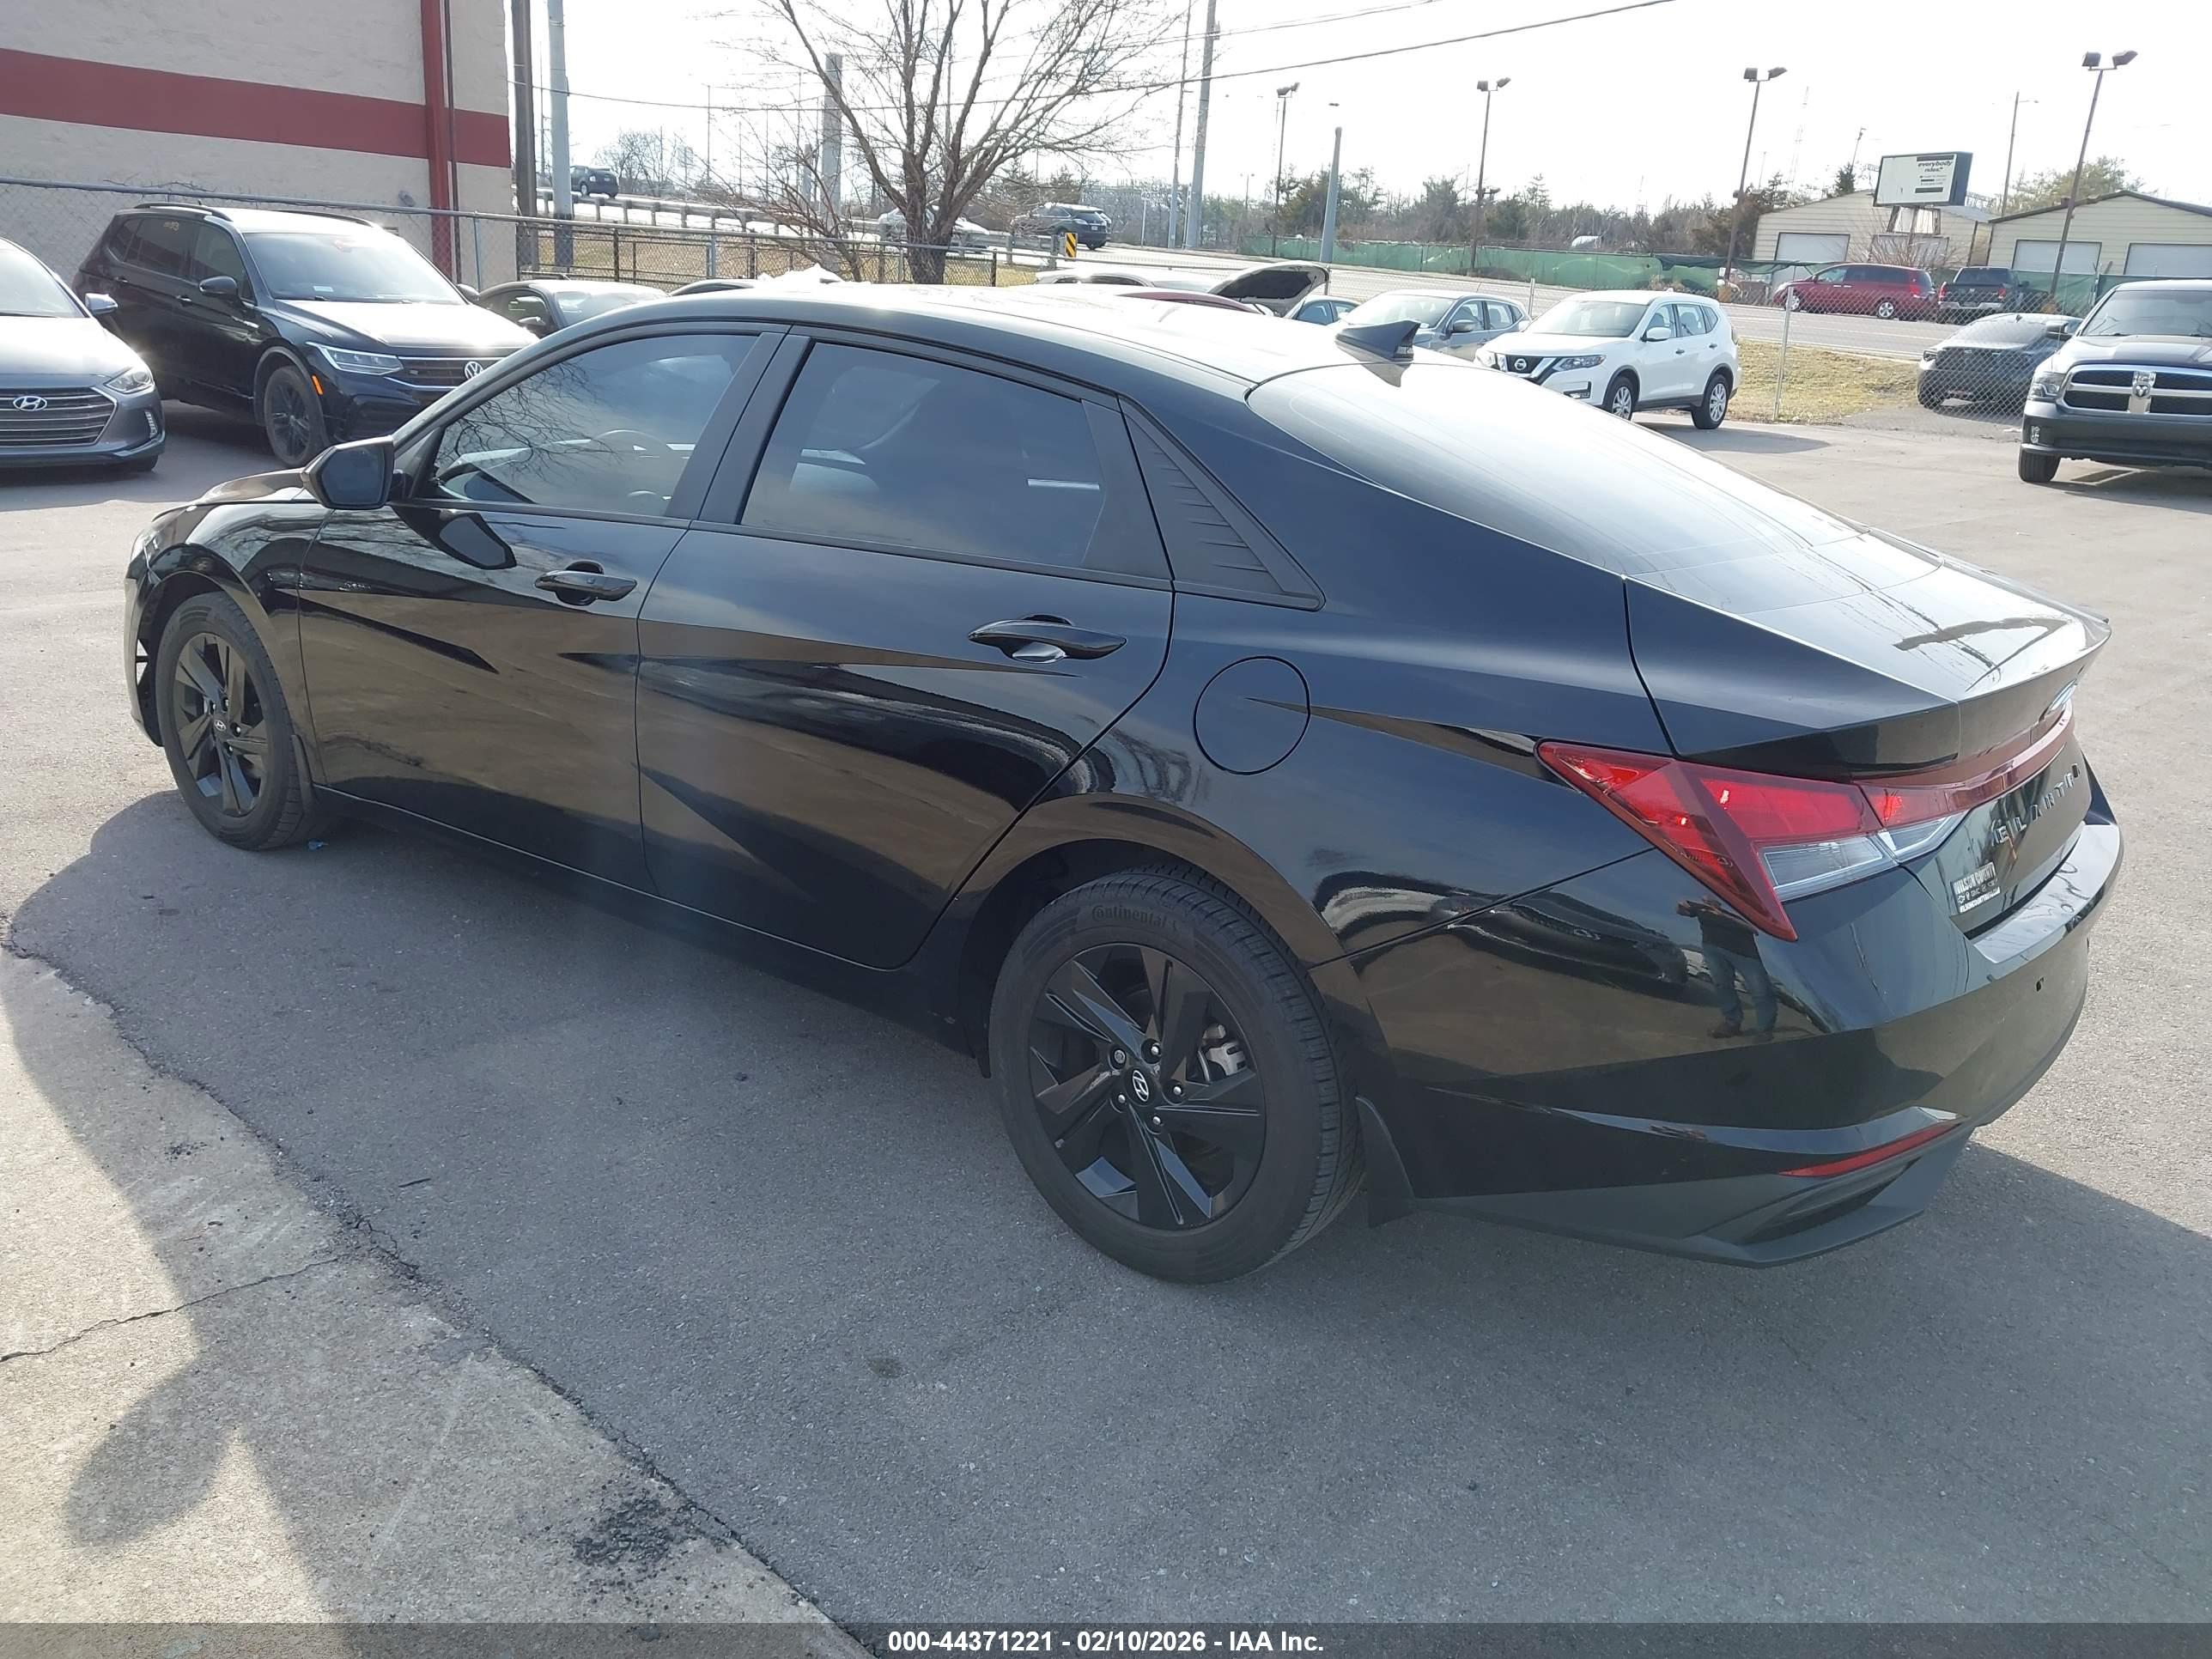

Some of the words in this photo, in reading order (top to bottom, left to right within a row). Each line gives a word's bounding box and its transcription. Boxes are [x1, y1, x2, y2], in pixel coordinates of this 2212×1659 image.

[1917, 160, 1953, 168] everybody
[1953, 873, 1977, 895] WILSON
[1974, 862, 1996, 885] COUNTY
[1091, 904, 1167, 928] Continental
